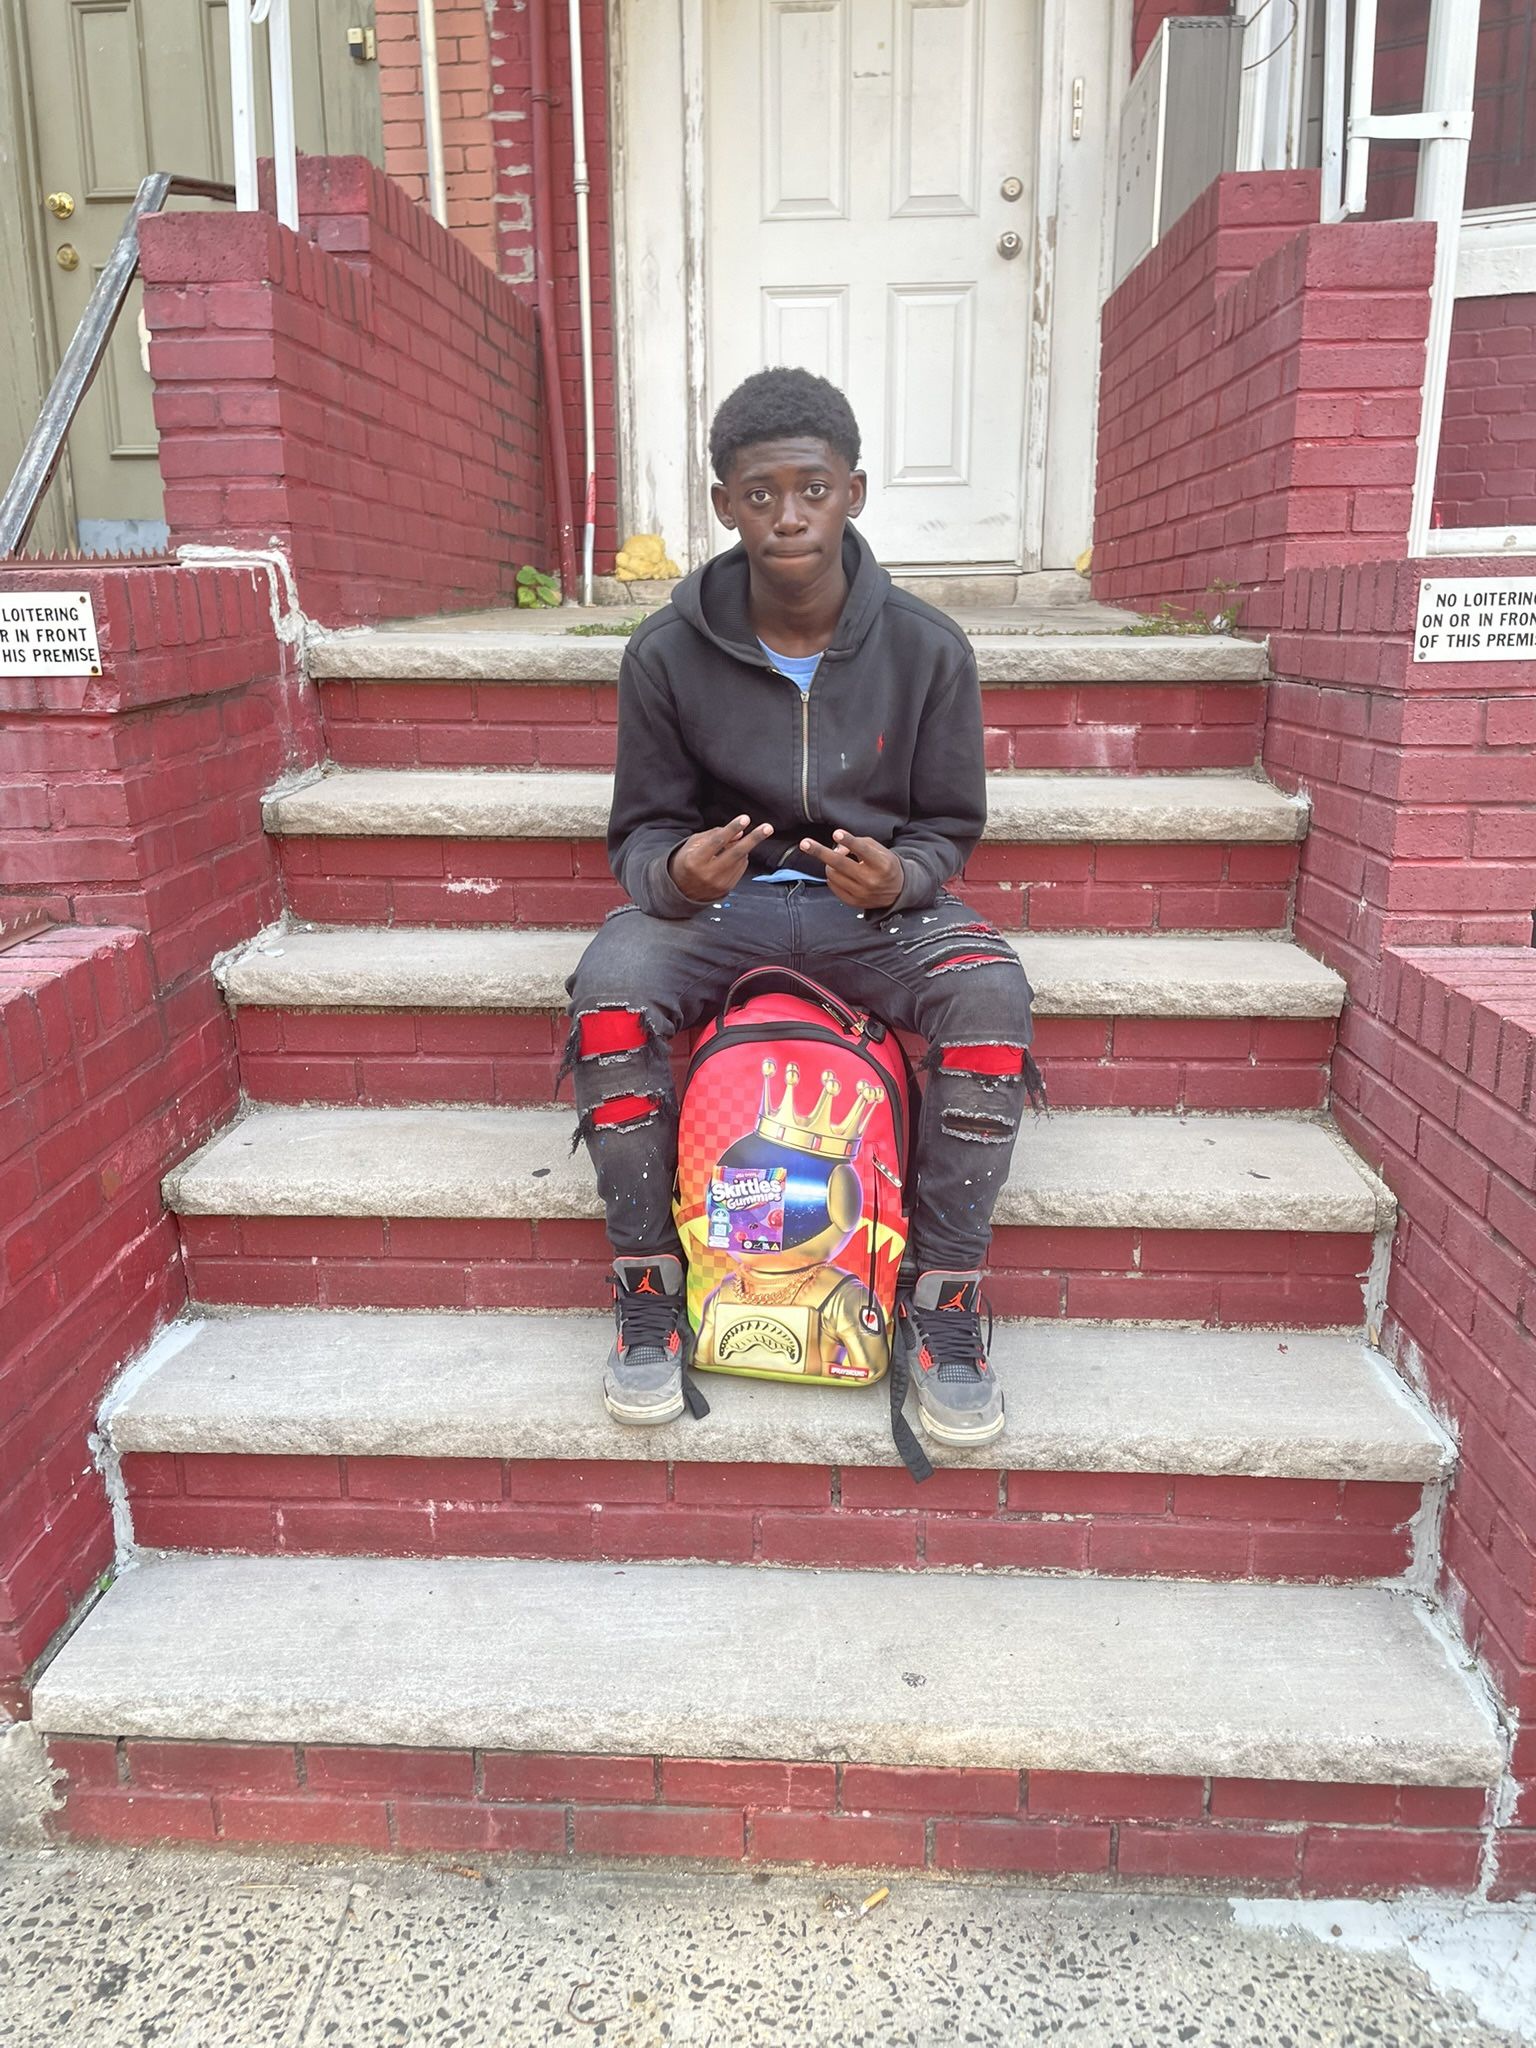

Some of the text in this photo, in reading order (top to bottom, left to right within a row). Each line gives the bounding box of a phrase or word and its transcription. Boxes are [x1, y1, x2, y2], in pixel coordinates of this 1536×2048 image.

[1436, 591, 1536, 607] NO LOITERIN
[2, 607, 79, 622] LOITERING
[1422, 613, 1443, 628] ON
[1449, 613, 1470, 627] OR
[1479, 612, 1493, 627] IN
[15, 629, 30, 643] IN
[36, 628, 87, 642] FRONT
[1419, 632, 1536, 648] OF THIS PREMI
[2, 648, 97, 663] HIS PREMISE
[711, 1177, 782, 1202] Skittles
[726, 1193, 782, 1210] Gummies
